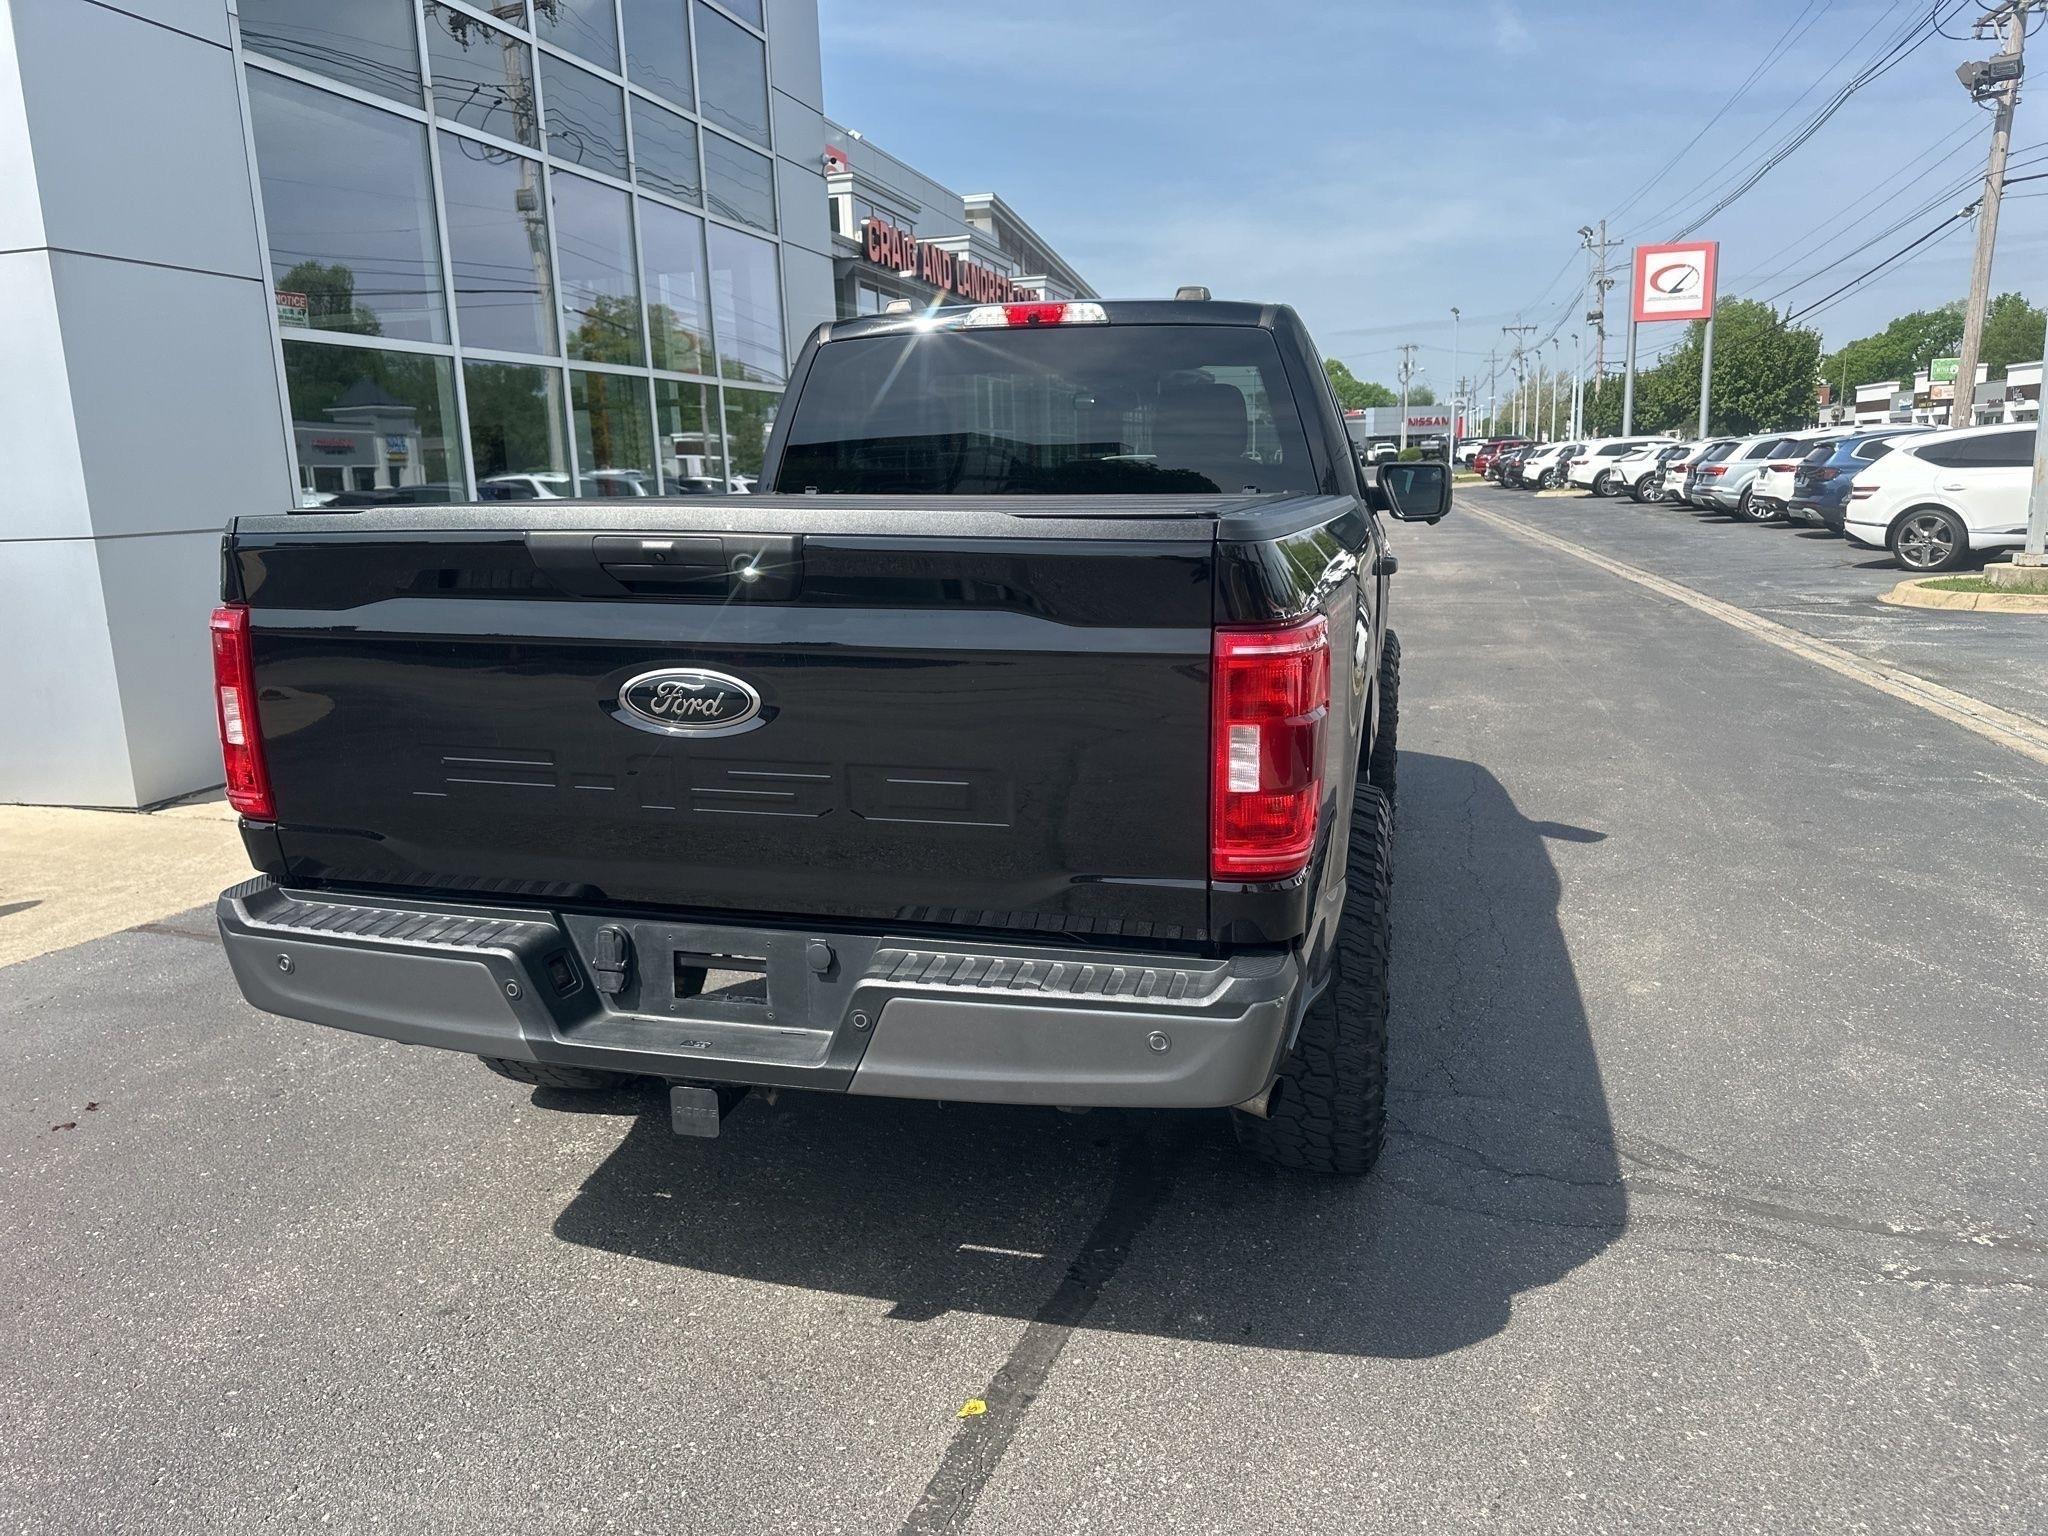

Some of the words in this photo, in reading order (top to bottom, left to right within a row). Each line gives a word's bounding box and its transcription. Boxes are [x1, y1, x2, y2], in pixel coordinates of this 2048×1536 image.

[867, 216, 918, 277] CRAIG
[922, 242, 952, 290] AND
[275, 294, 306, 308] NOTICE
[1408, 415, 1450, 427] NISSAN
[650, 681, 725, 717] Ford
